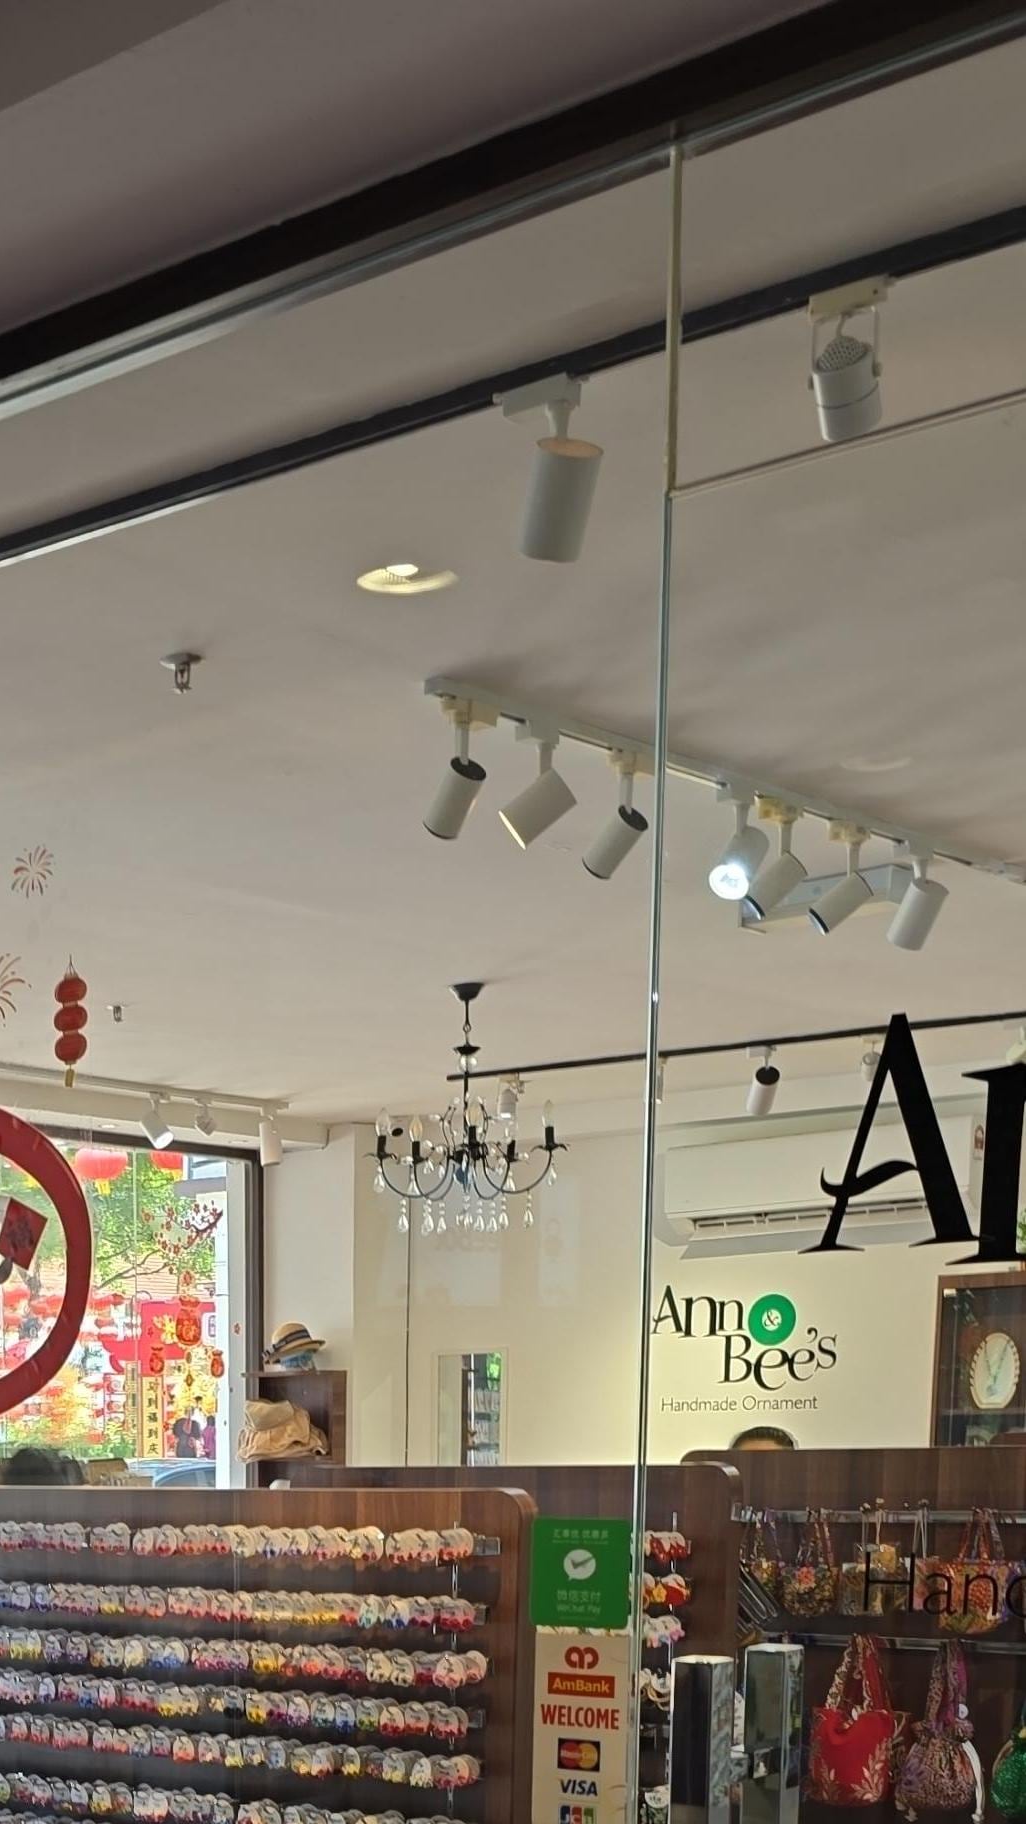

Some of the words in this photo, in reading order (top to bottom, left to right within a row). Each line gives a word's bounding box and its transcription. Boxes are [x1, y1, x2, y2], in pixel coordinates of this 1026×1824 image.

[651, 1285, 745, 1338] Ann
[661, 1396, 737, 1412] Handmade
[742, 1395, 818, 1411] Ornament
[553, 1678, 610, 1693] AmBank
[541, 1704, 620, 1730] WELCOME
[559, 1779, 598, 1796] VISA
